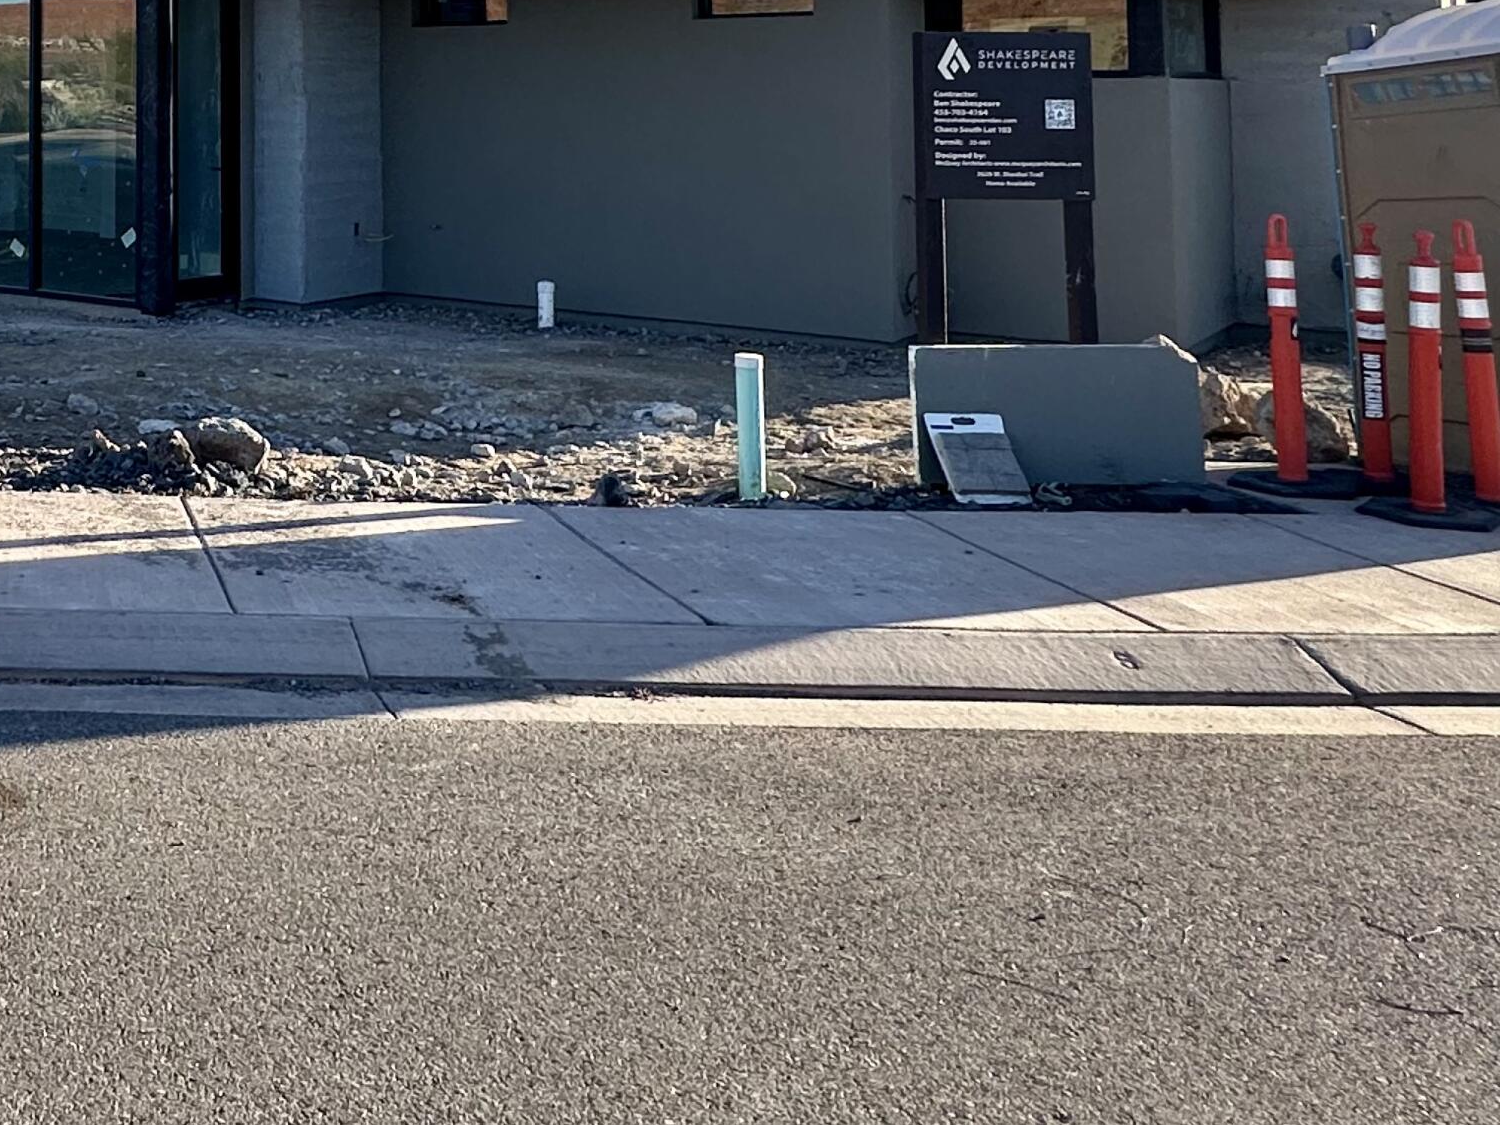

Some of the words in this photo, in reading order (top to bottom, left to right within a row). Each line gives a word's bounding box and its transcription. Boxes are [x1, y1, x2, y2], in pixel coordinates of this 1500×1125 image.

[977, 49, 1076, 60] SHAKESPEARE
[977, 61, 1076, 70] DEVELOPMENT
[950, 99, 1001, 107] Shakespeare
[934, 152, 972, 160] Designed
[1362, 353, 1381, 369] NO
[1363, 370, 1383, 418] PARKING
